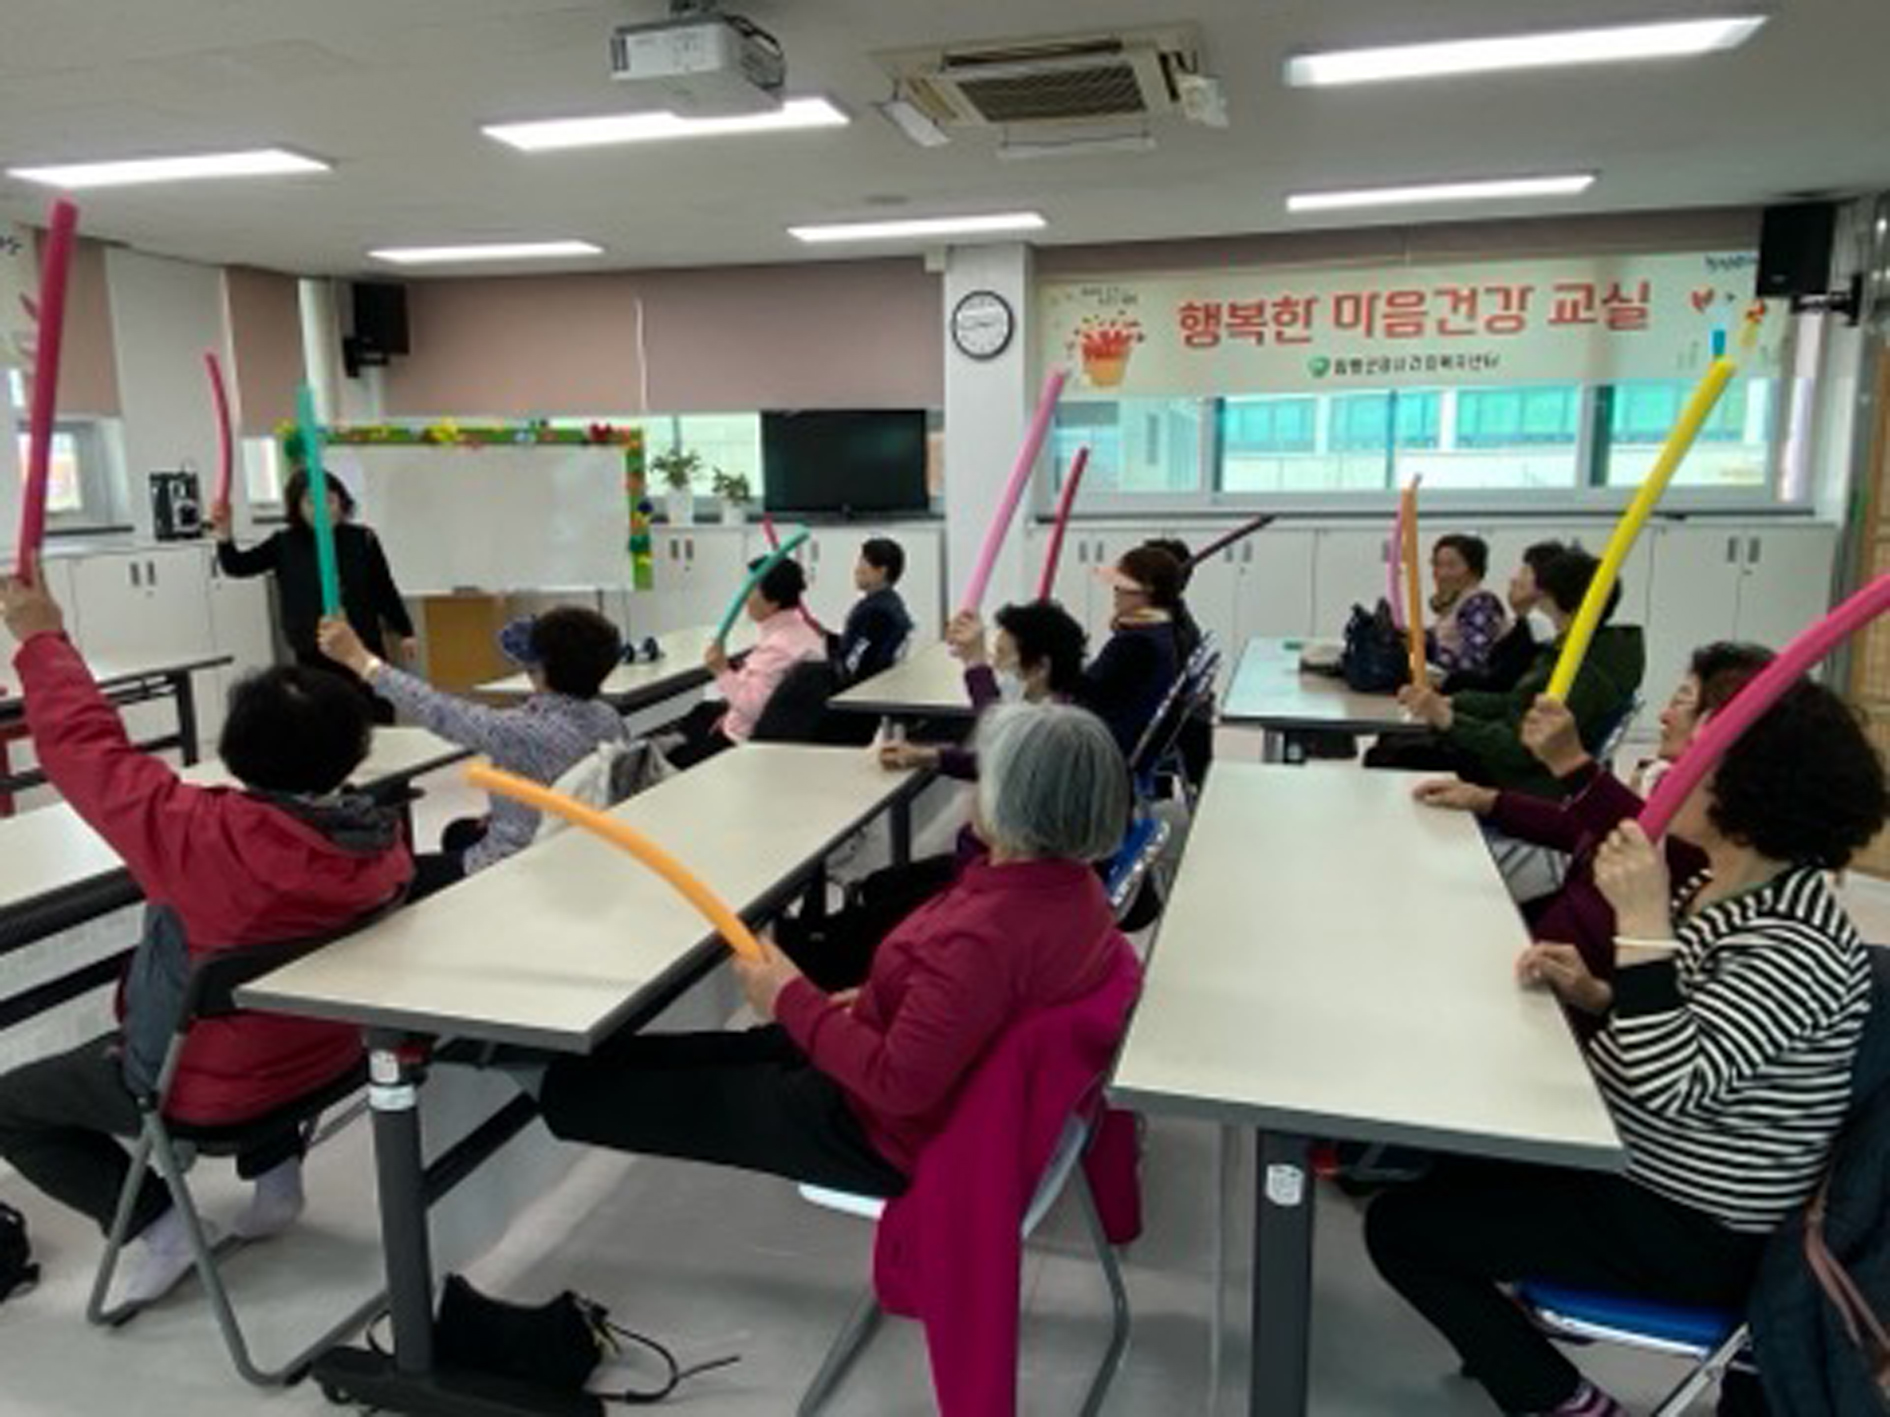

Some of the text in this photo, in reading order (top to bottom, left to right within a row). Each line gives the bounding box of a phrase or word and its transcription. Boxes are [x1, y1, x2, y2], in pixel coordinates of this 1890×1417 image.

[1179, 280, 1651, 347] 행복한 마음건강 교실
